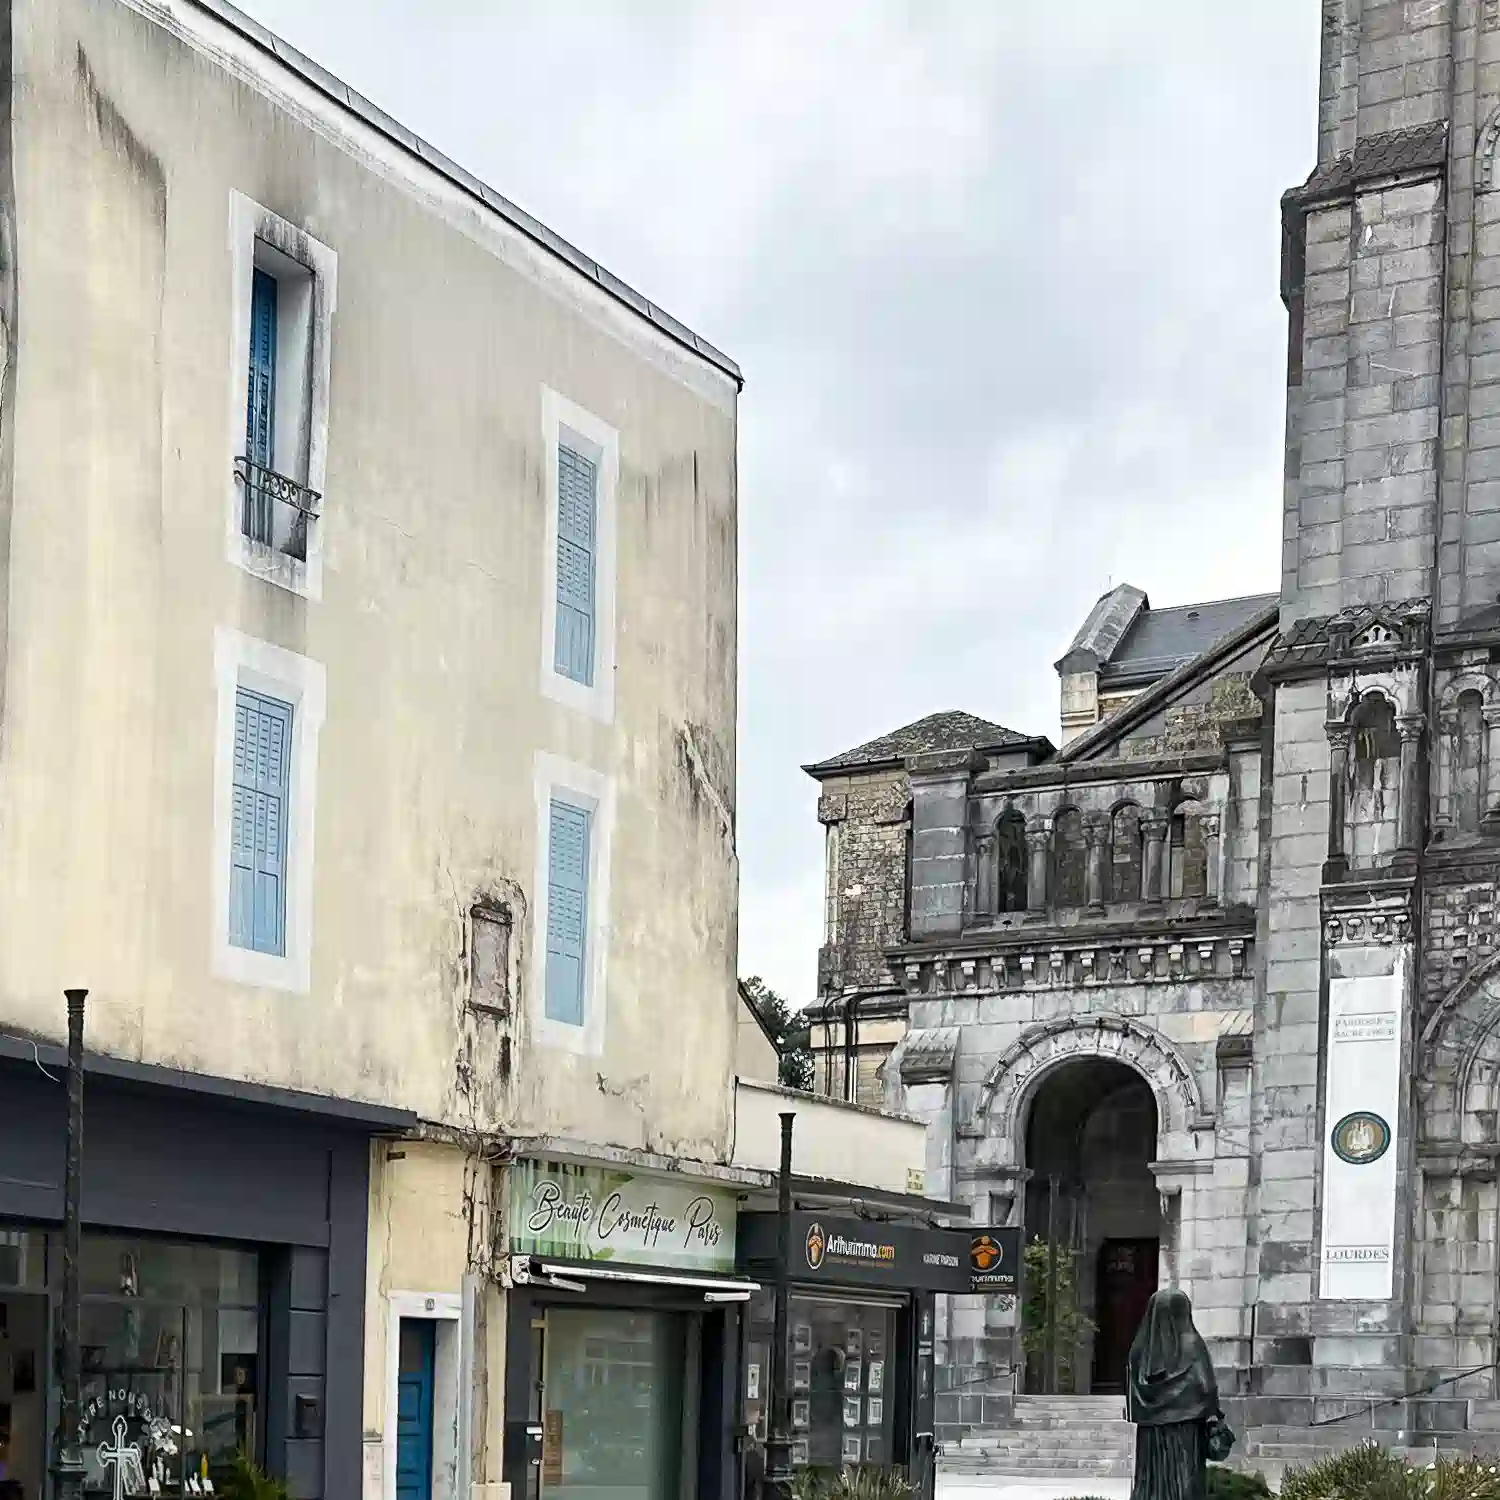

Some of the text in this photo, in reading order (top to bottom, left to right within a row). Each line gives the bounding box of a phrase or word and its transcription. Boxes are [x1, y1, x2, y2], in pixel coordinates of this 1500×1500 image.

[528, 1181, 723, 1249] Beauté Cosmétique Paris
[1326, 1249, 1389, 1260] LOURDES
[108, 1388, 144, 1410] NOUS
